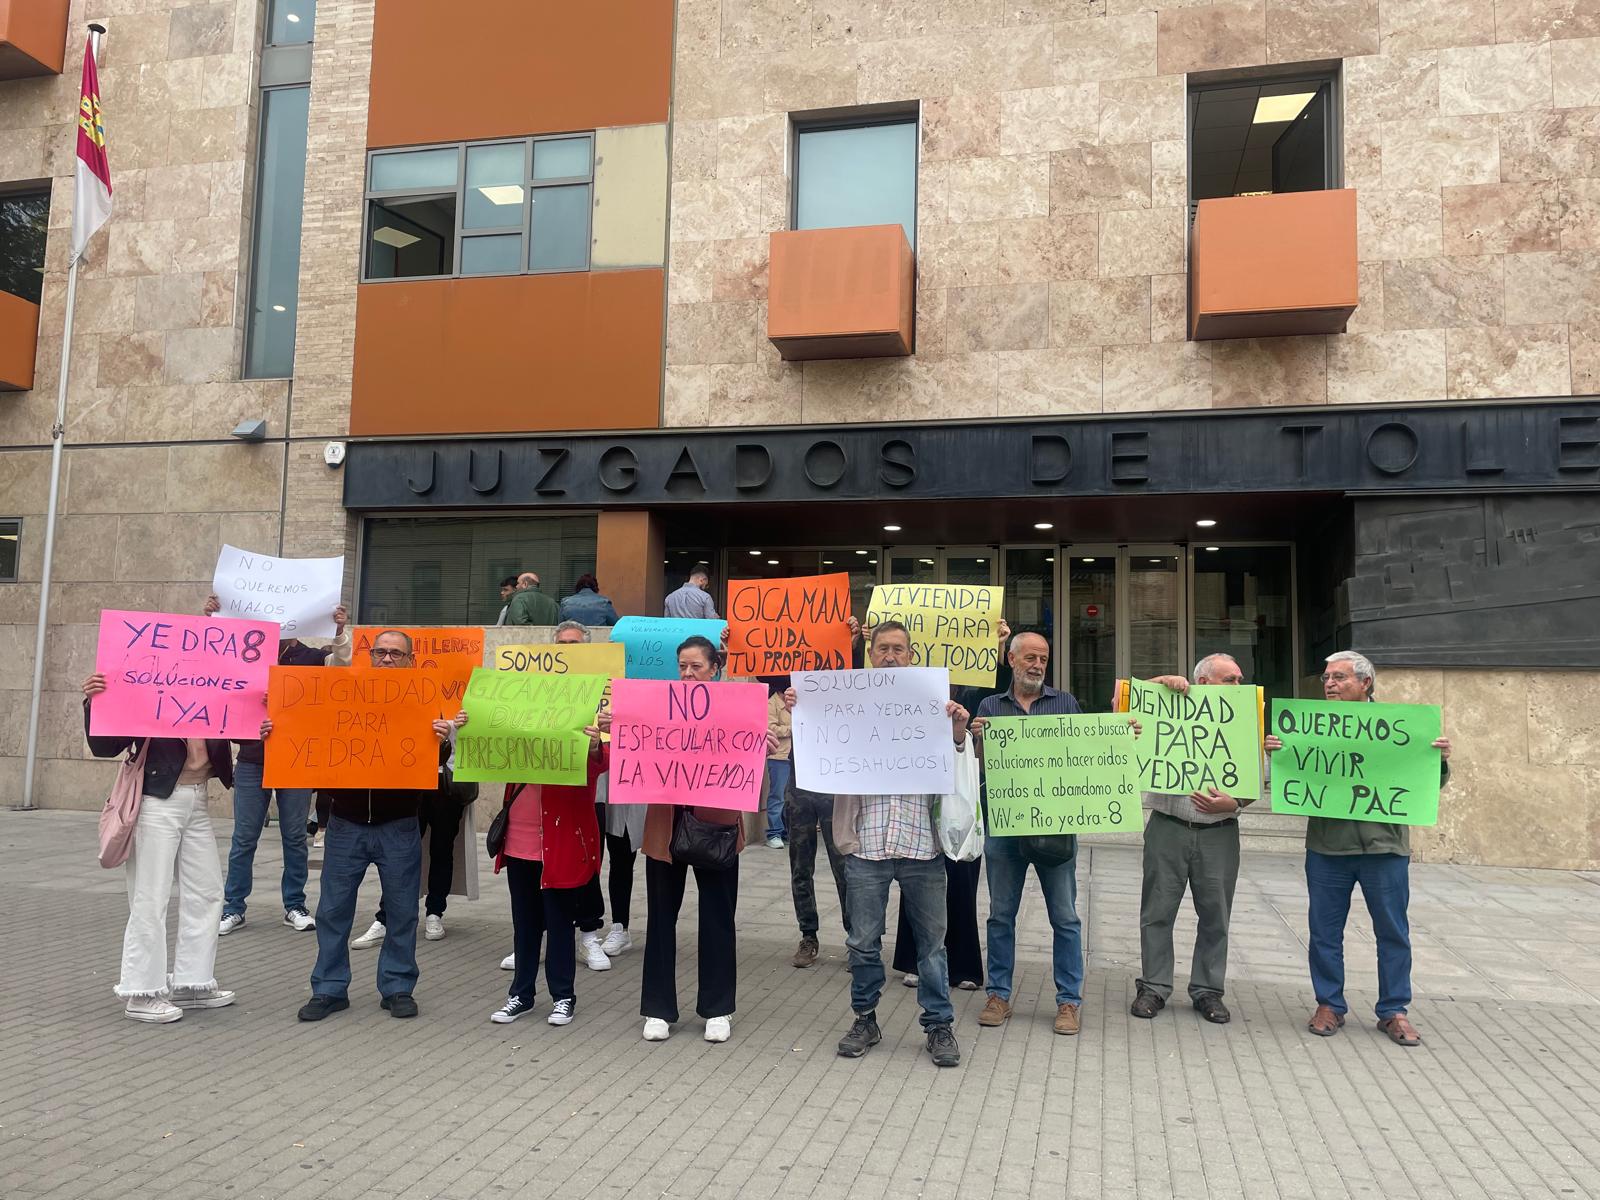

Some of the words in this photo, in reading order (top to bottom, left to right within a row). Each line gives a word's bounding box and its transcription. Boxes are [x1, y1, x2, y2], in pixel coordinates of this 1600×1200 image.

[406, 438, 917, 496] JUZGADOS
[1030, 430, 1150, 484] DE
[239, 555, 273, 572] NO
[234, 577, 309, 593] QUEREMOS
[880, 586, 991, 610] VIVIENDA
[230, 599, 285, 615] MALOS
[732, 585, 850, 624] GICAMAN
[745, 626, 812, 649] CUIDA
[935, 614, 990, 638] PARA
[641, 639, 663, 652] NO
[940, 643, 998, 673] TODOS
[500, 650, 569, 674] SOMOS
[626, 653, 633, 665] A
[639, 656, 664, 666] LOS
[729, 651, 756, 674] TU
[762, 648, 845, 673] PROPIEDAD
[282, 674, 437, 708] DIGNIDAD
[469, 674, 598, 705] GICAMAN
[803, 672, 896, 692] SOLUCION
[669, 682, 711, 721] NO
[824, 702, 865, 717] PARA
[873, 702, 923, 717] YEDRA
[928, 699, 940, 716] 8
[1131, 685, 1235, 724] DIGNIDAD
[336, 710, 388, 735] PARA
[488, 704, 577, 730] DUEÑO
[1278, 708, 1410, 746] QUEREMOS
[618, 724, 728, 754] ESPECULAR
[731, 730, 768, 753] CON
[869, 726, 881, 743] A
[891, 725, 926, 742] LOS
[982, 720, 1018, 748] Page,
[1083, 724, 1096, 737] es
[1097, 716, 1131, 737] buscar
[1154, 720, 1232, 760] PARA
[289, 737, 385, 769] YEDRA
[400, 737, 417, 768] 8
[457, 736, 580, 772] IRRESPONSABLE
[1065, 746, 1095, 768] hacer
[1097, 745, 1128, 767] oidos
[1291, 744, 1365, 779] VIVIR
[618, 758, 645, 788] LA
[654, 760, 756, 794] VIVIENDA
[988, 777, 1029, 800] sordos
[1033, 776, 1046, 798] al
[1117, 773, 1134, 795] de
[1283, 779, 1328, 809] EN
[1030, 806, 1053, 828] Rio
